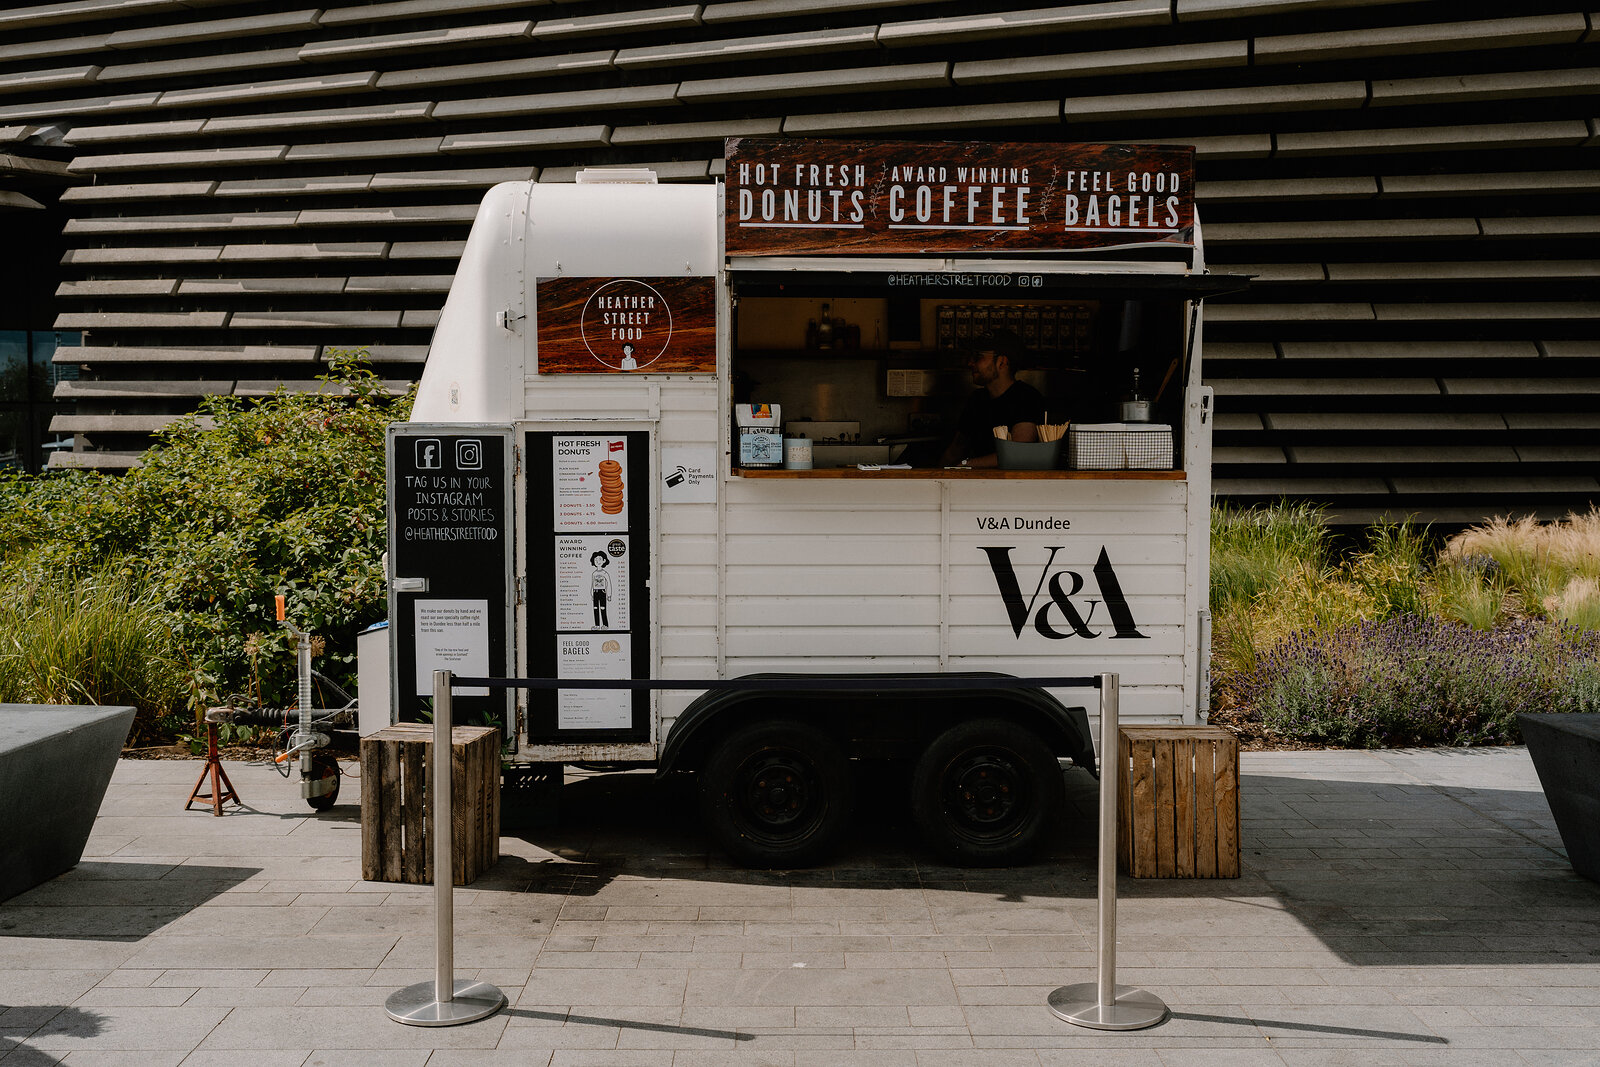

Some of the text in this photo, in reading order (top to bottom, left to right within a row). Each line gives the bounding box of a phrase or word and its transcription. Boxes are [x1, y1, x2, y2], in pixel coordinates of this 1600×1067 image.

[740, 164, 864, 186] HOT FRESH
[892, 166, 1029, 184] AWARD WINNING
[1067, 171, 1179, 192] FEEL GOOD
[740, 189, 864, 222] DONUTS
[890, 185, 1030, 223] COFFEE
[1066, 194, 1179, 227] BAGELS
[888, 274, 1012, 286] @HEATHERSTREETFOOD
[599, 296, 654, 308] HEATHER
[604, 313, 650, 325] STREET
[612, 328, 642, 340] FOOD
[405, 476, 492, 489] TAG US IN YOUR
[416, 492, 483, 506] INSTAGRAM
[408, 508, 495, 521] POSTS & STORIES
[976, 517, 1070, 530] V&A Dundee
[405, 526, 497, 541] @HEATHERSTREETFOOD
[976, 544, 1151, 640] V&A
